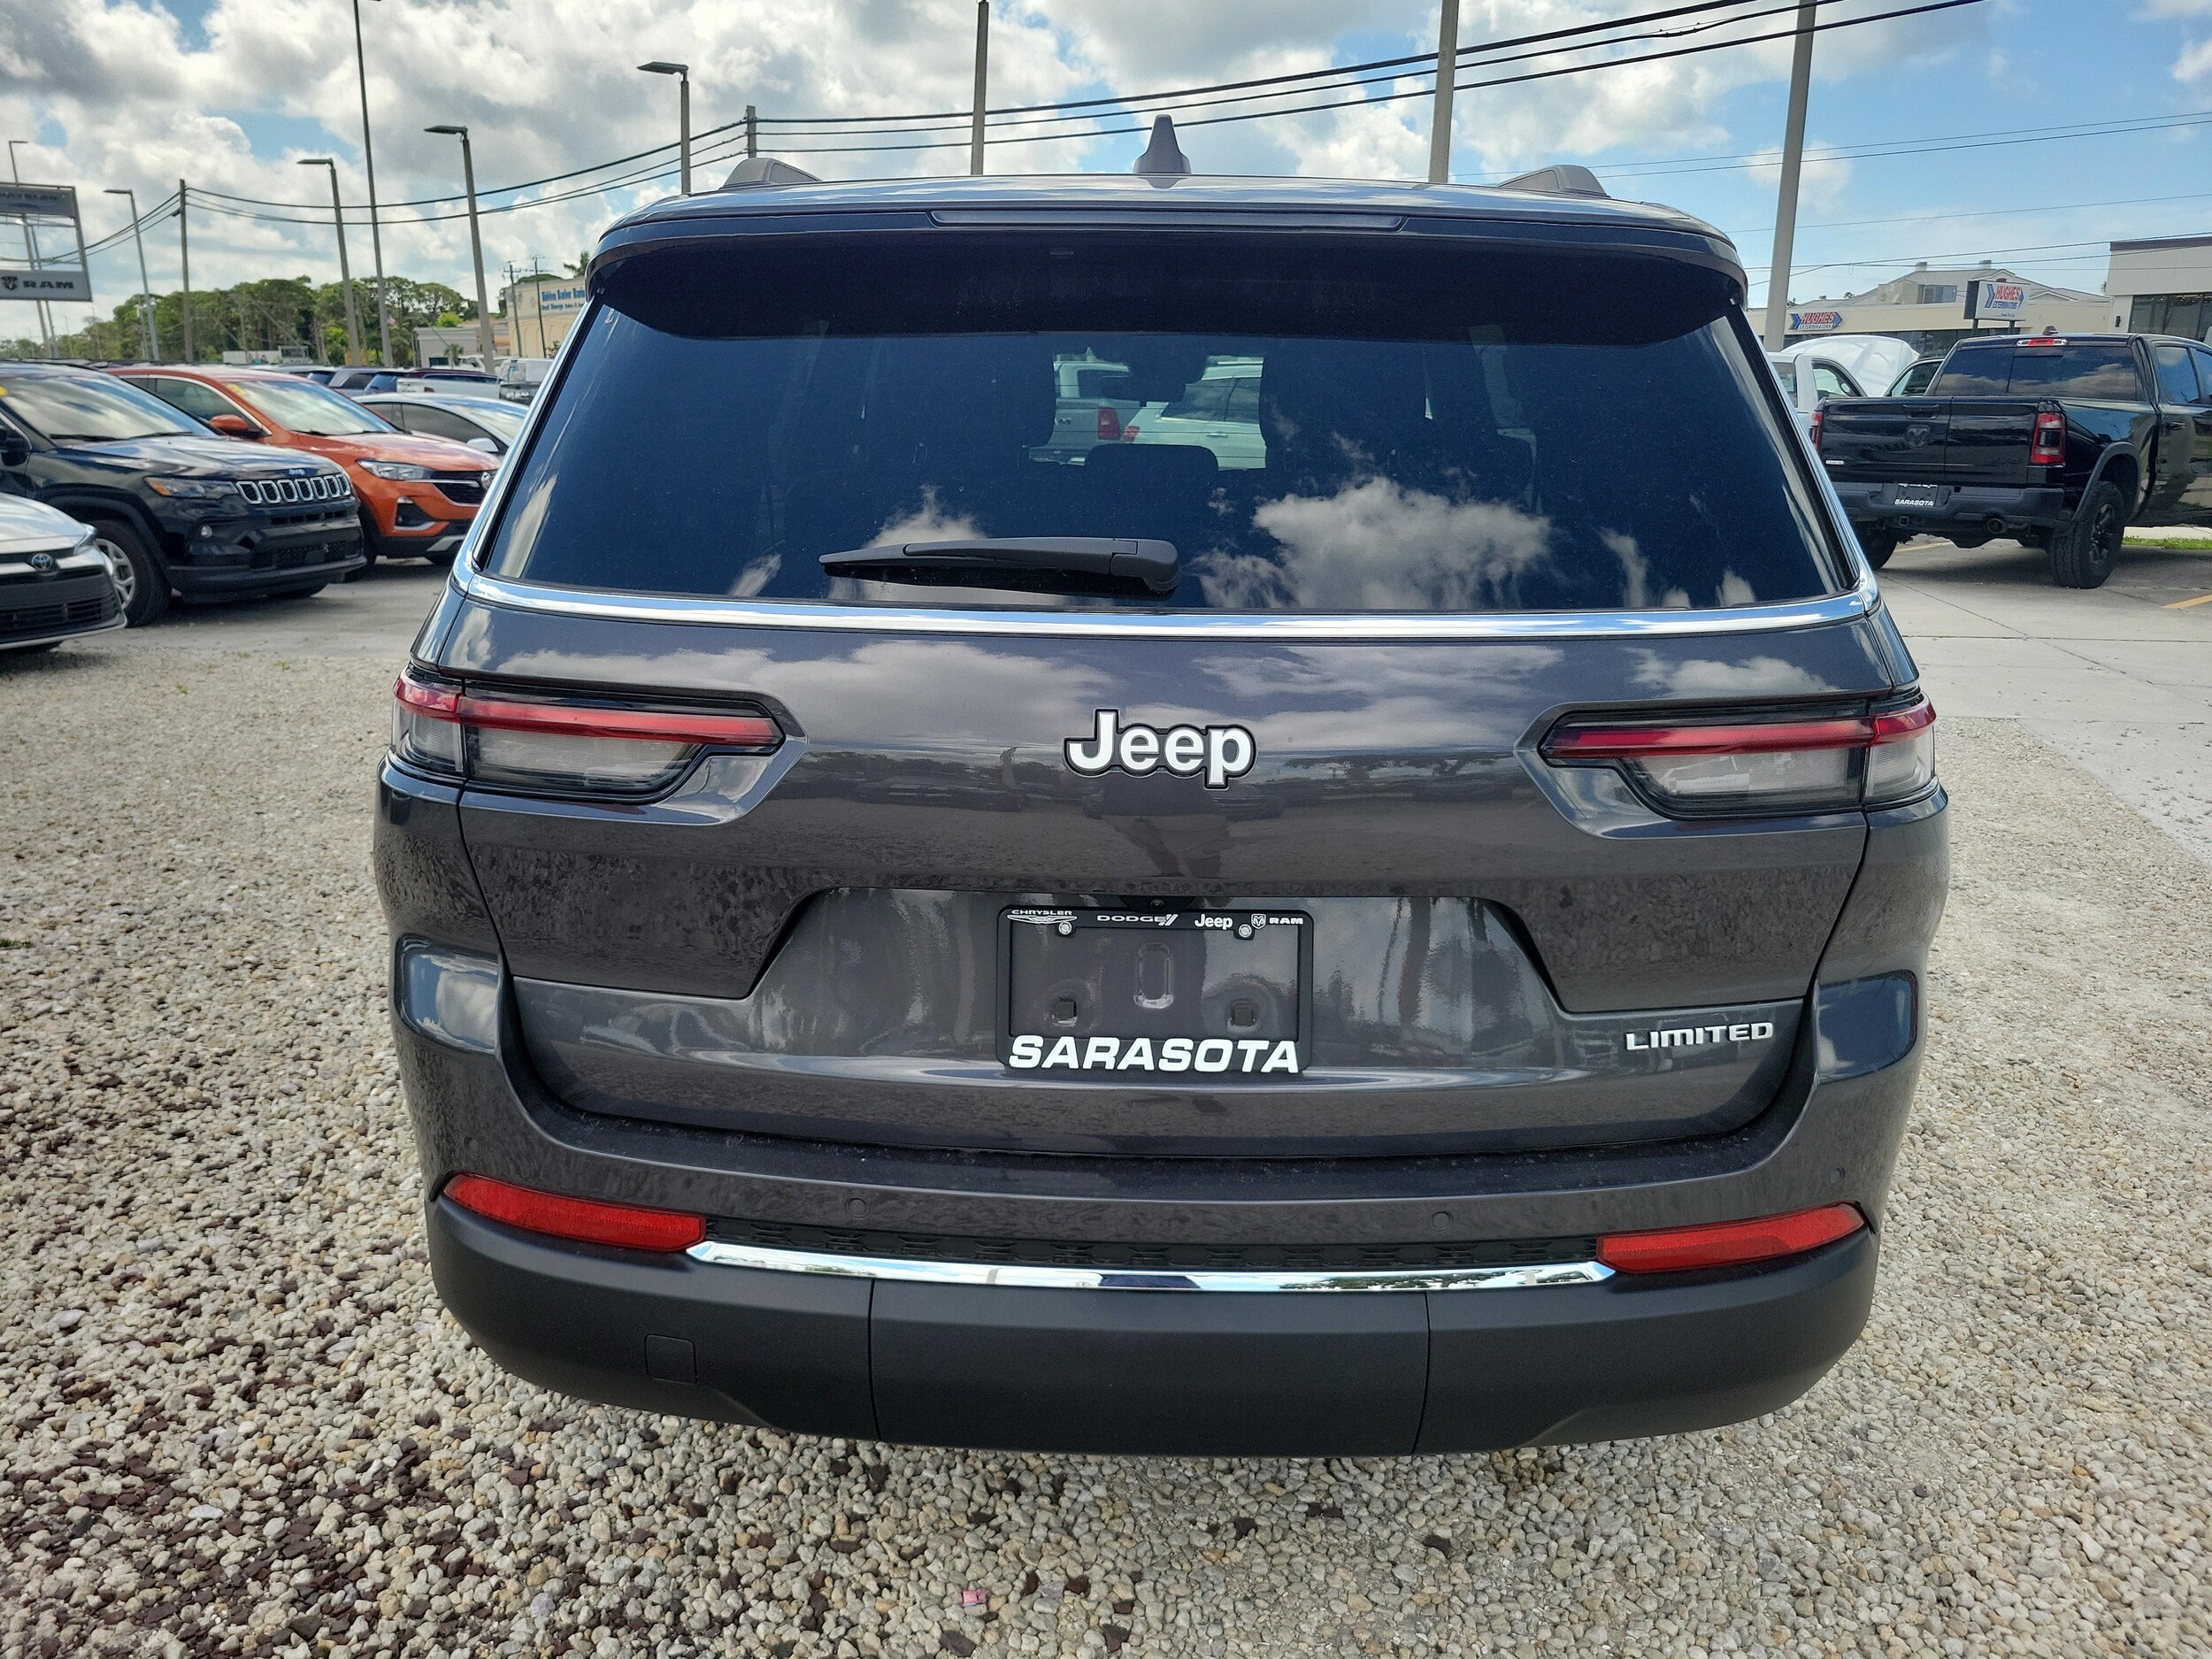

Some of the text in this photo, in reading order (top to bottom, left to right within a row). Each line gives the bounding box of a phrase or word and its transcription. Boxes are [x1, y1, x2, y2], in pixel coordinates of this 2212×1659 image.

[23, 280, 74, 289] RAM
[1994, 285, 2021, 301] HUGHES
[1801, 312, 1836, 324] HUGHES
[1894, 498, 1934, 507] SARASOTA
[1066, 709, 1255, 787] Jeep
[1096, 914, 1168, 923] DODGE
[1194, 913, 1233, 930] Jeep
[1624, 1022, 1774, 1051] LIMITED
[1008, 1034, 1300, 1074] SARASOTA
